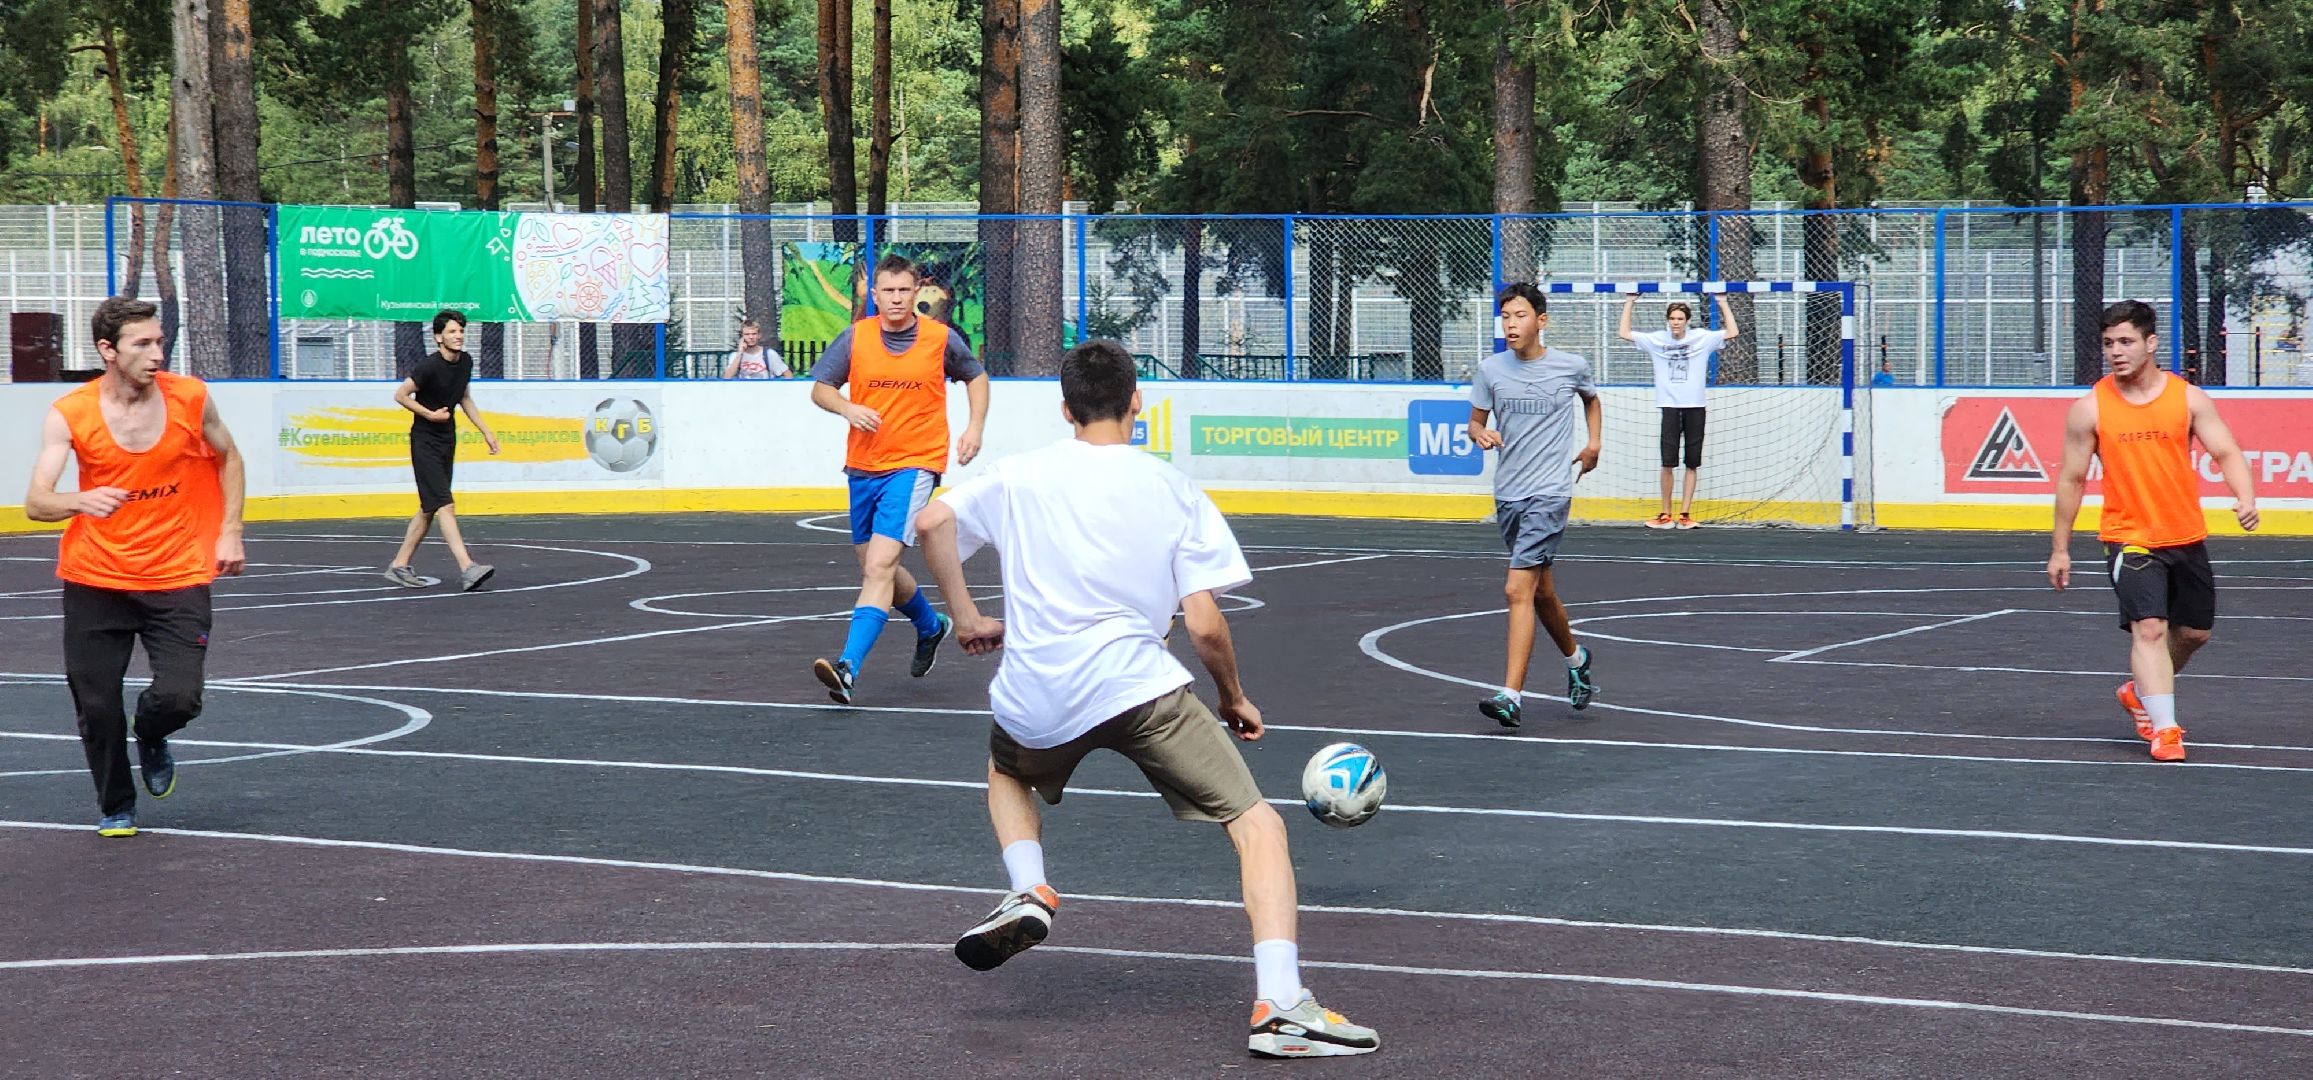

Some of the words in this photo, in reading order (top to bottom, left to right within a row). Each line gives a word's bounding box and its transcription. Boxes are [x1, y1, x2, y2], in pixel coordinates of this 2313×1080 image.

[300, 226, 361, 246] лето
[868, 380, 922, 390] DEMIX
[1201, 425, 1323, 447] ТОРГОВЫЙ
[1328, 429, 1399, 449] ЦЕНТР
[2118, 431, 2169, 443] KIPSTA
[126, 482, 180, 501] EMIX
